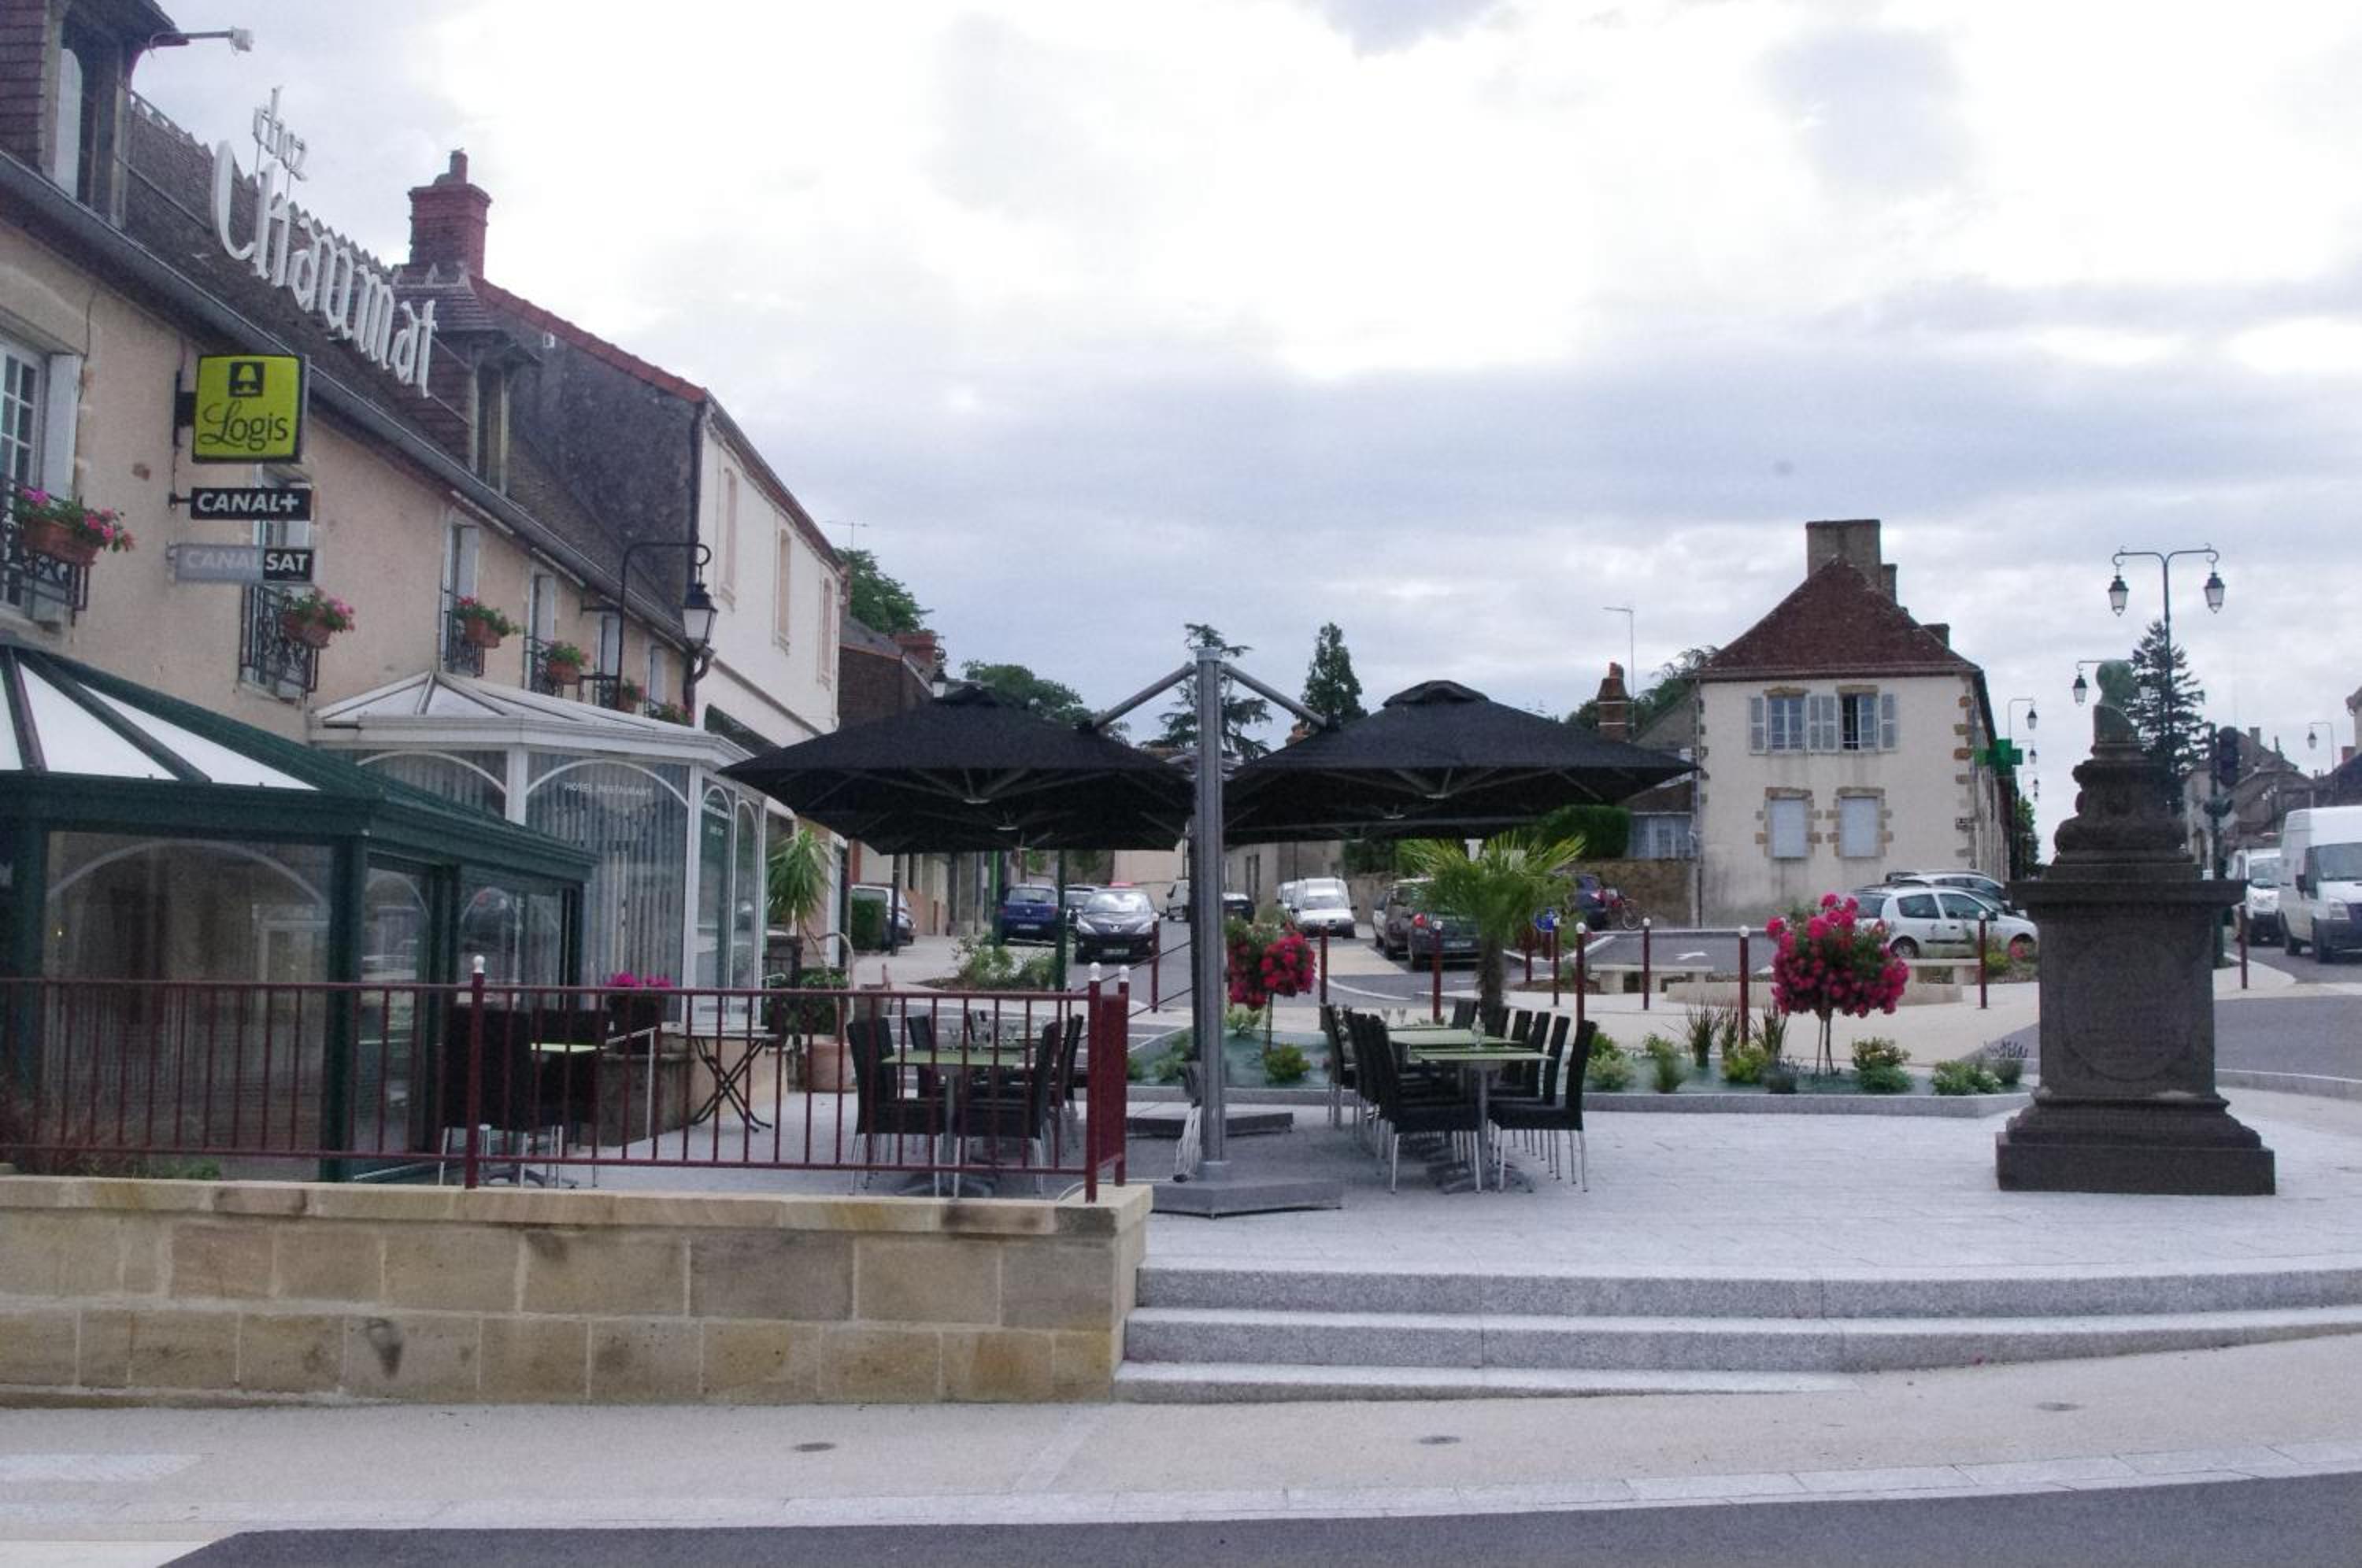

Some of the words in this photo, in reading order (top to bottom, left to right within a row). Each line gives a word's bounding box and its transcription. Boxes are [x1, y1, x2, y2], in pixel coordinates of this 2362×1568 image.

[210, 139, 439, 398] Chaumat
[198, 400, 289, 452] Logis
[197, 491, 300, 513] CANAL+
